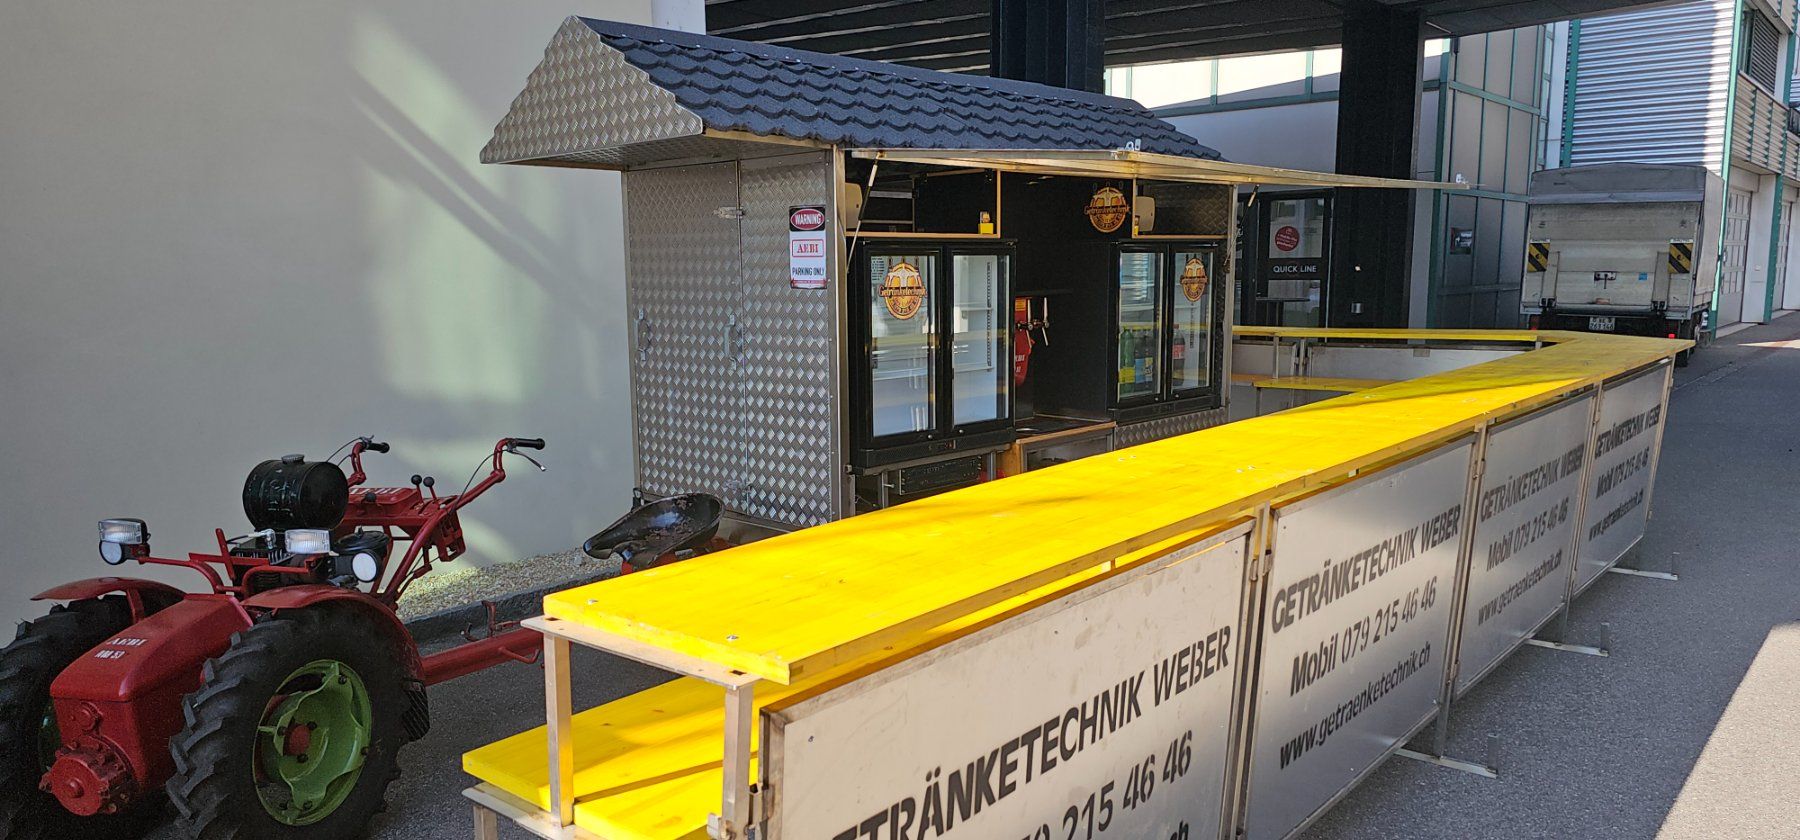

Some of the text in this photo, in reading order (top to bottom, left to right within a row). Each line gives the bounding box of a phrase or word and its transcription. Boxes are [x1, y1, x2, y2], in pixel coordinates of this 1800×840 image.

[794, 213, 822, 225] WARNING
[797, 243, 820, 254] AEBI
[792, 266, 825, 277] PARKING ONLY
[1273, 265, 1317, 273] QUICK LINE
[1480, 456, 1560, 522] GETRÄNKETECHNIK
[1271, 503, 1461, 634] GETRÄNKETECHNIK WEBER
[1486, 529, 1513, 572] Mobil
[1513, 520, 1531, 554] 079
[1531, 511, 1547, 543] 215
[1290, 575, 1438, 697] Mobil 079 215 46 46
[831, 625, 1231, 840] TRÄNKETECHNIK WEBER
[1279, 641, 1431, 770] www.getraenketechnik.ch
[1062, 730, 1193, 840] 215 46 46
